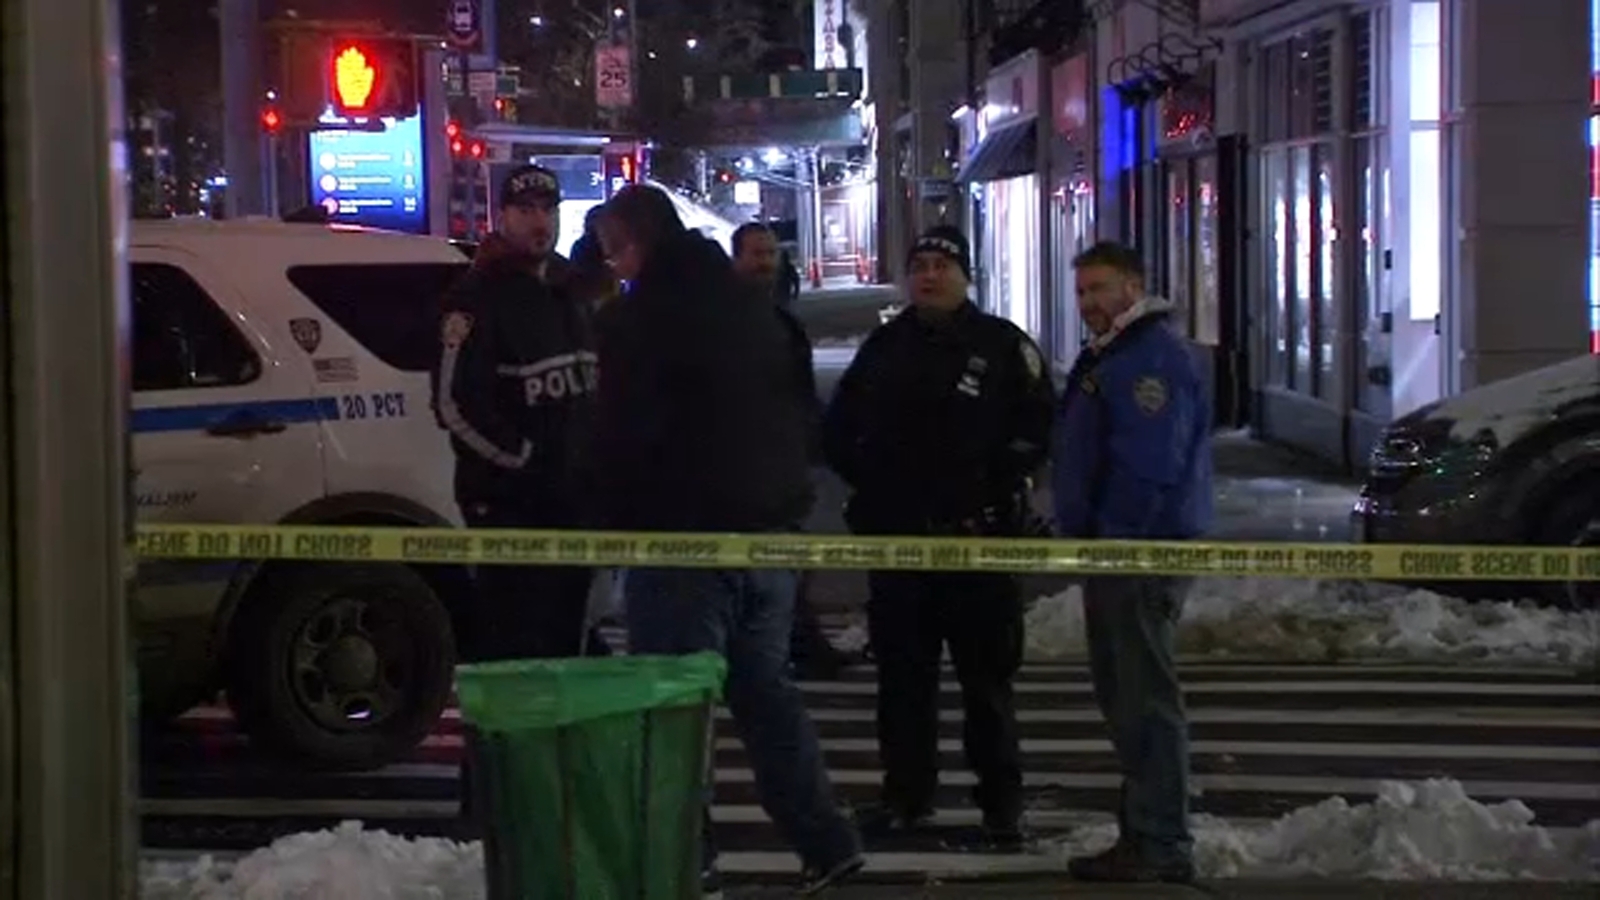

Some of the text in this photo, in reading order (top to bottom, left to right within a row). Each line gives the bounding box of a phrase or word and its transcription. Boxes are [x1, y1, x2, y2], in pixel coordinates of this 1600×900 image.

[600, 70, 626, 88] 25
[343, 392, 405, 418] 20 PCT
